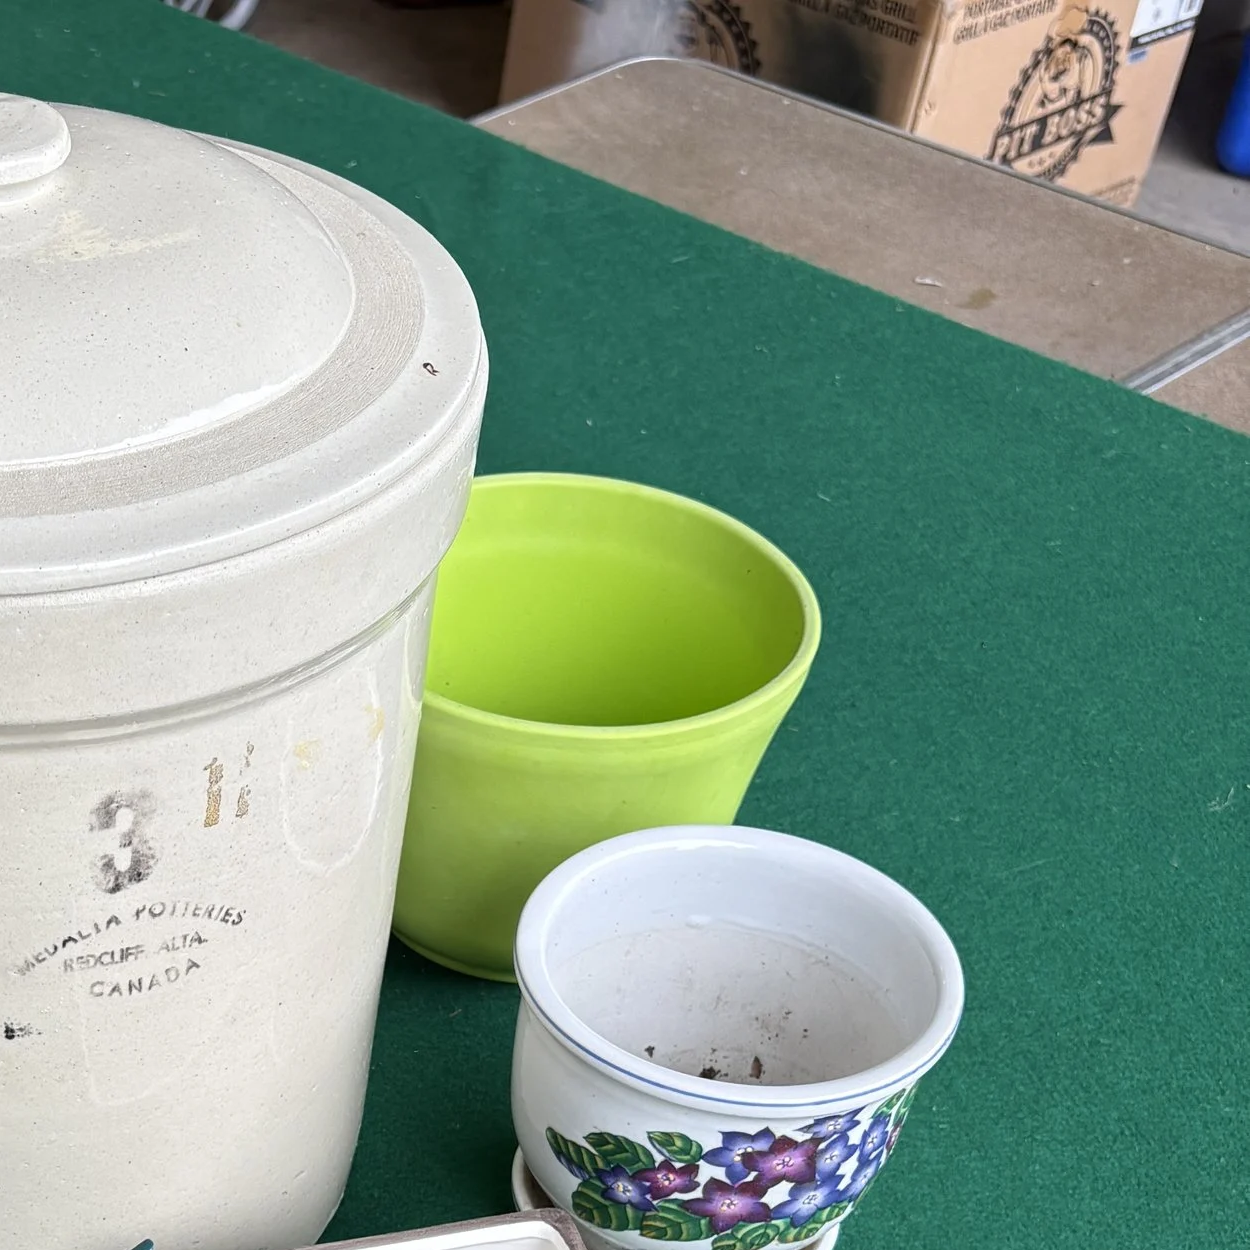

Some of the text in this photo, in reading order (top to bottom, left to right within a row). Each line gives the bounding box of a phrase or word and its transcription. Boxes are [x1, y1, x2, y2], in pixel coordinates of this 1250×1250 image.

[992, 121, 1039, 165] PIT
[1041, 96, 1107, 145] BOSS
[88, 789, 158, 893] 3
[134, 900, 247, 926] POTTERIES
[63, 945, 145, 972] REDCLIFF
[90, 958, 201, 997] CANADA
